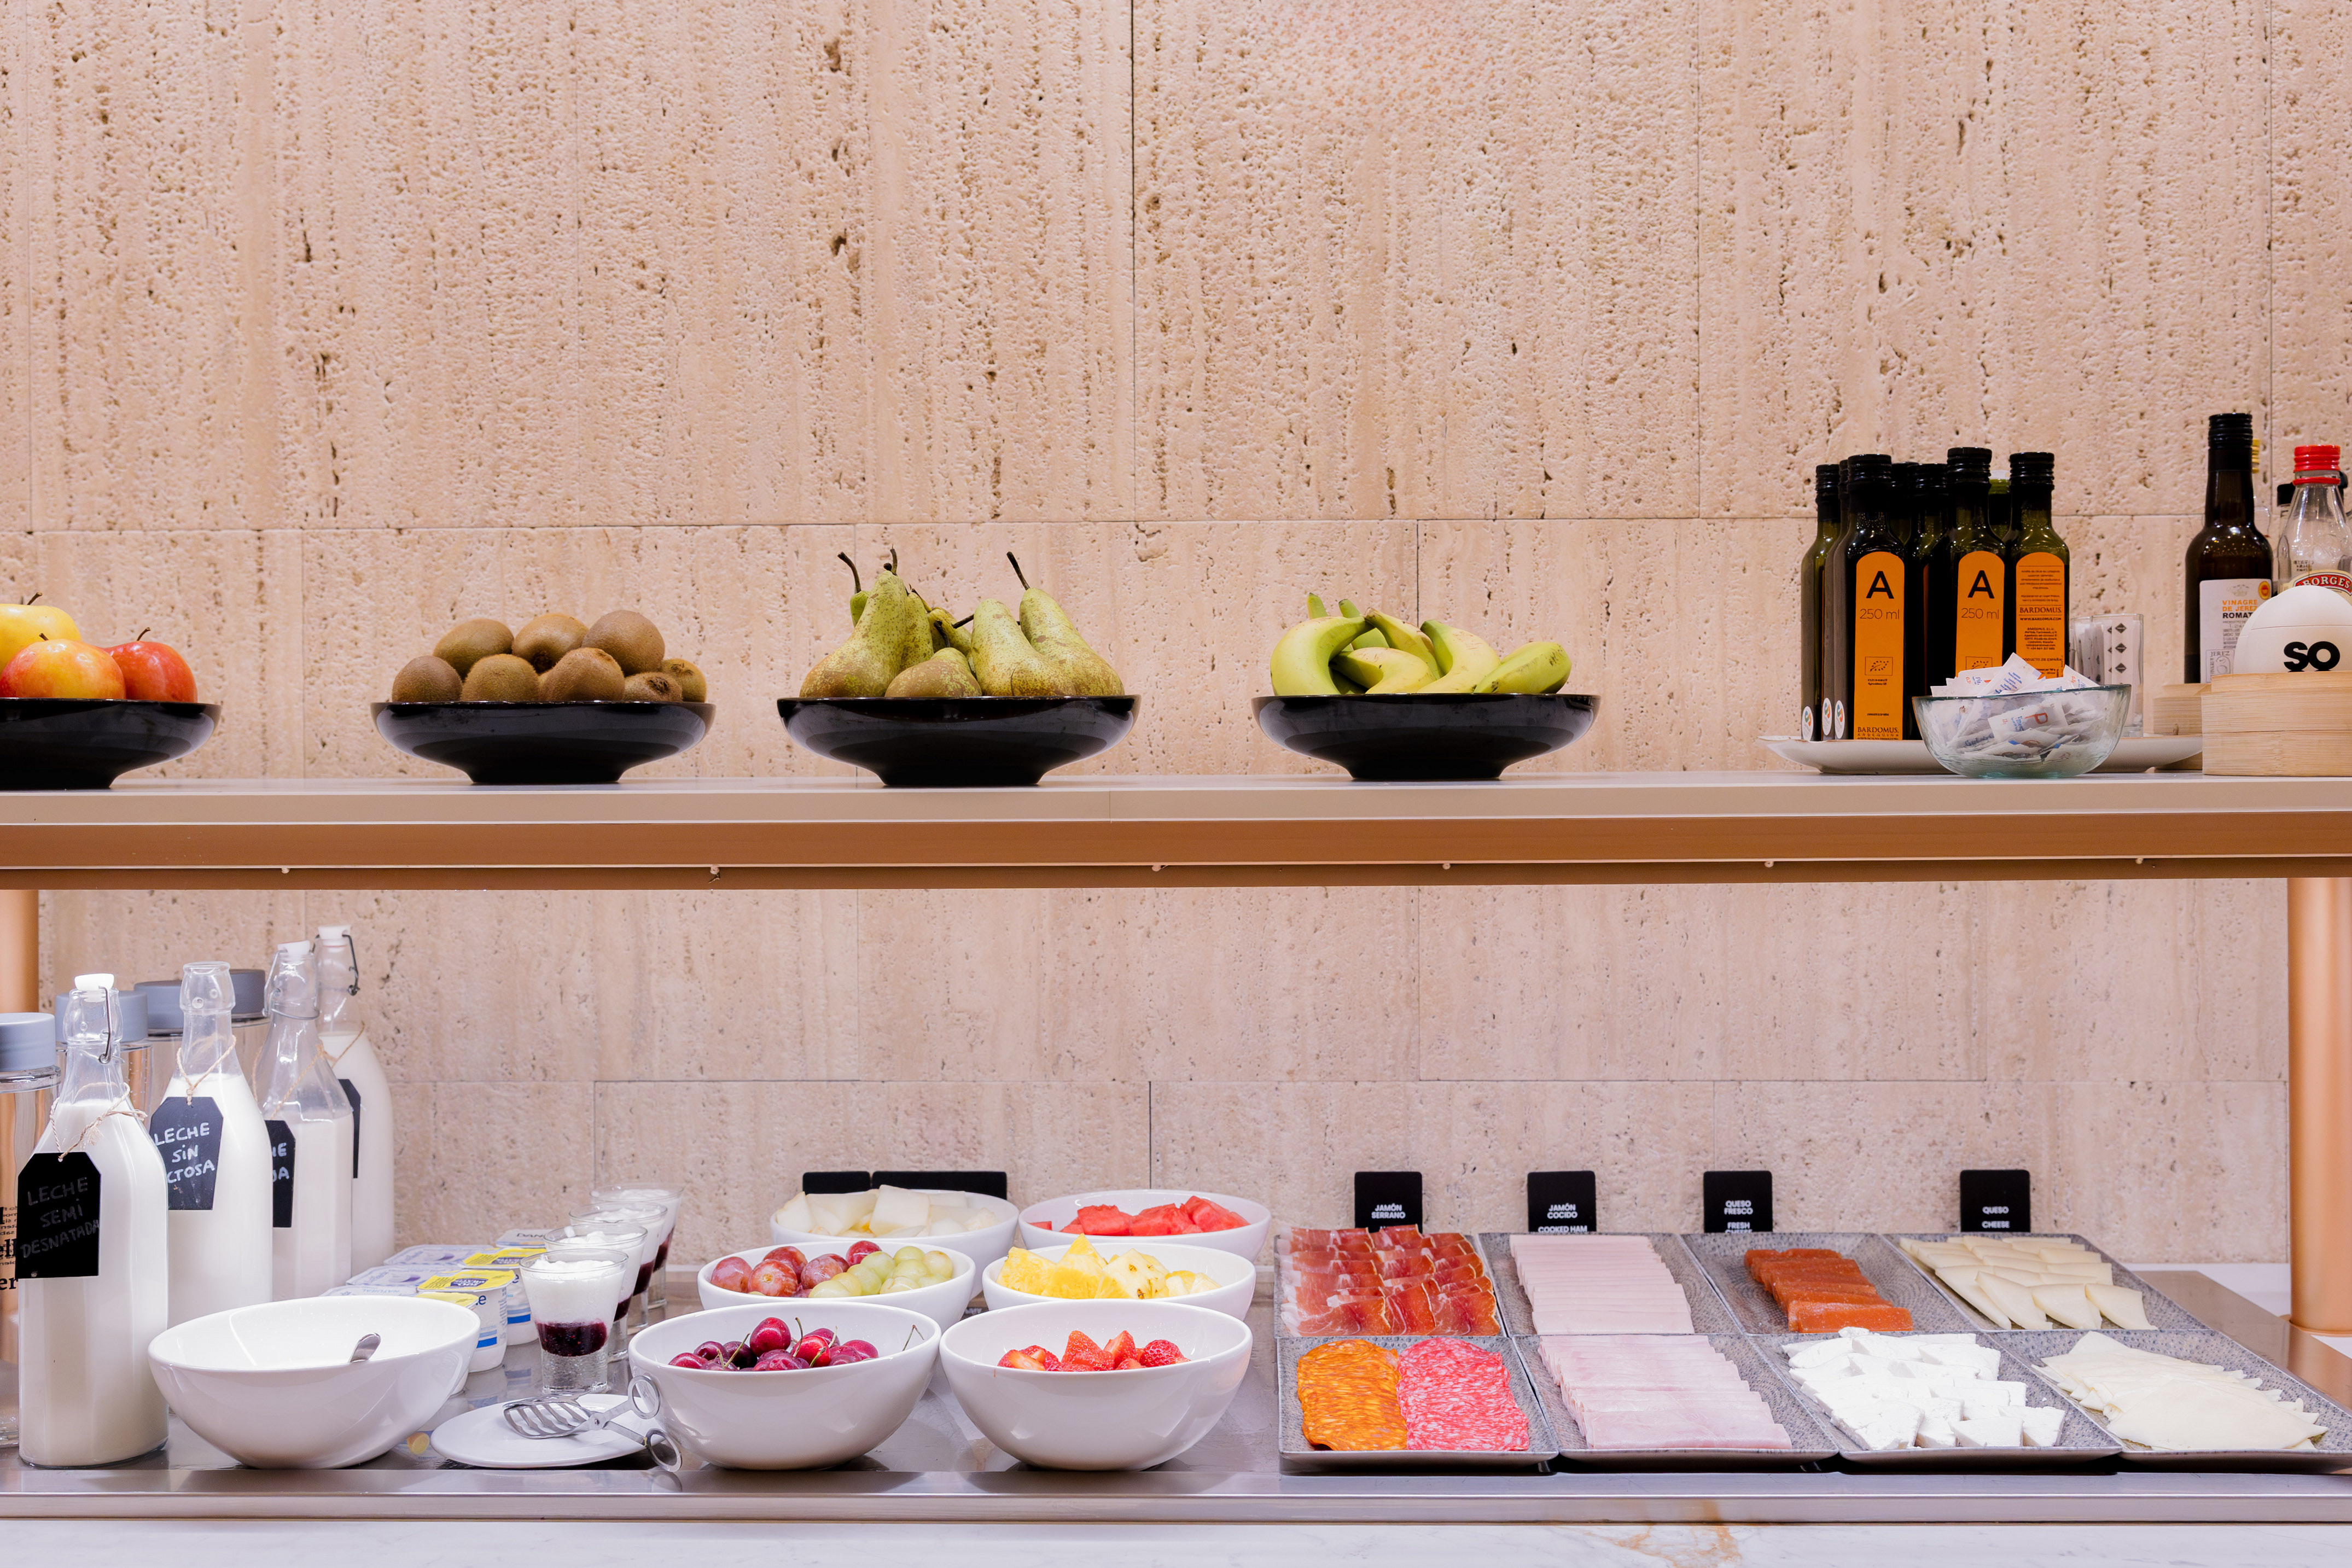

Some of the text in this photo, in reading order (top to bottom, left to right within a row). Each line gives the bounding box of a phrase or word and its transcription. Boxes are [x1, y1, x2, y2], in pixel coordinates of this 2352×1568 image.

[1866, 570, 1894, 599] A
[1967, 570, 1995, 599] A
[2302, 576, 2350, 588] BORGES
[1860, 608, 1900, 620] 250 ml
[1961, 608, 1999, 620] 250 ml
[2284, 641, 2340, 672] SO
[154, 1122, 209, 1146] LECHE
[167, 1159, 215, 1184] CTOSA
[27, 1177, 88, 1206] LECHE
[1375, 1203, 1402, 1211] JAMÓN
[1548, 1203, 1576, 1211] JAMÓN
[1725, 1200, 1751, 1208] QUESO
[1982, 1206, 2009, 1215] QUESO
[1570, 1225, 1587, 1233] HAM
[20, 1219, 100, 1258] DESNATADA
